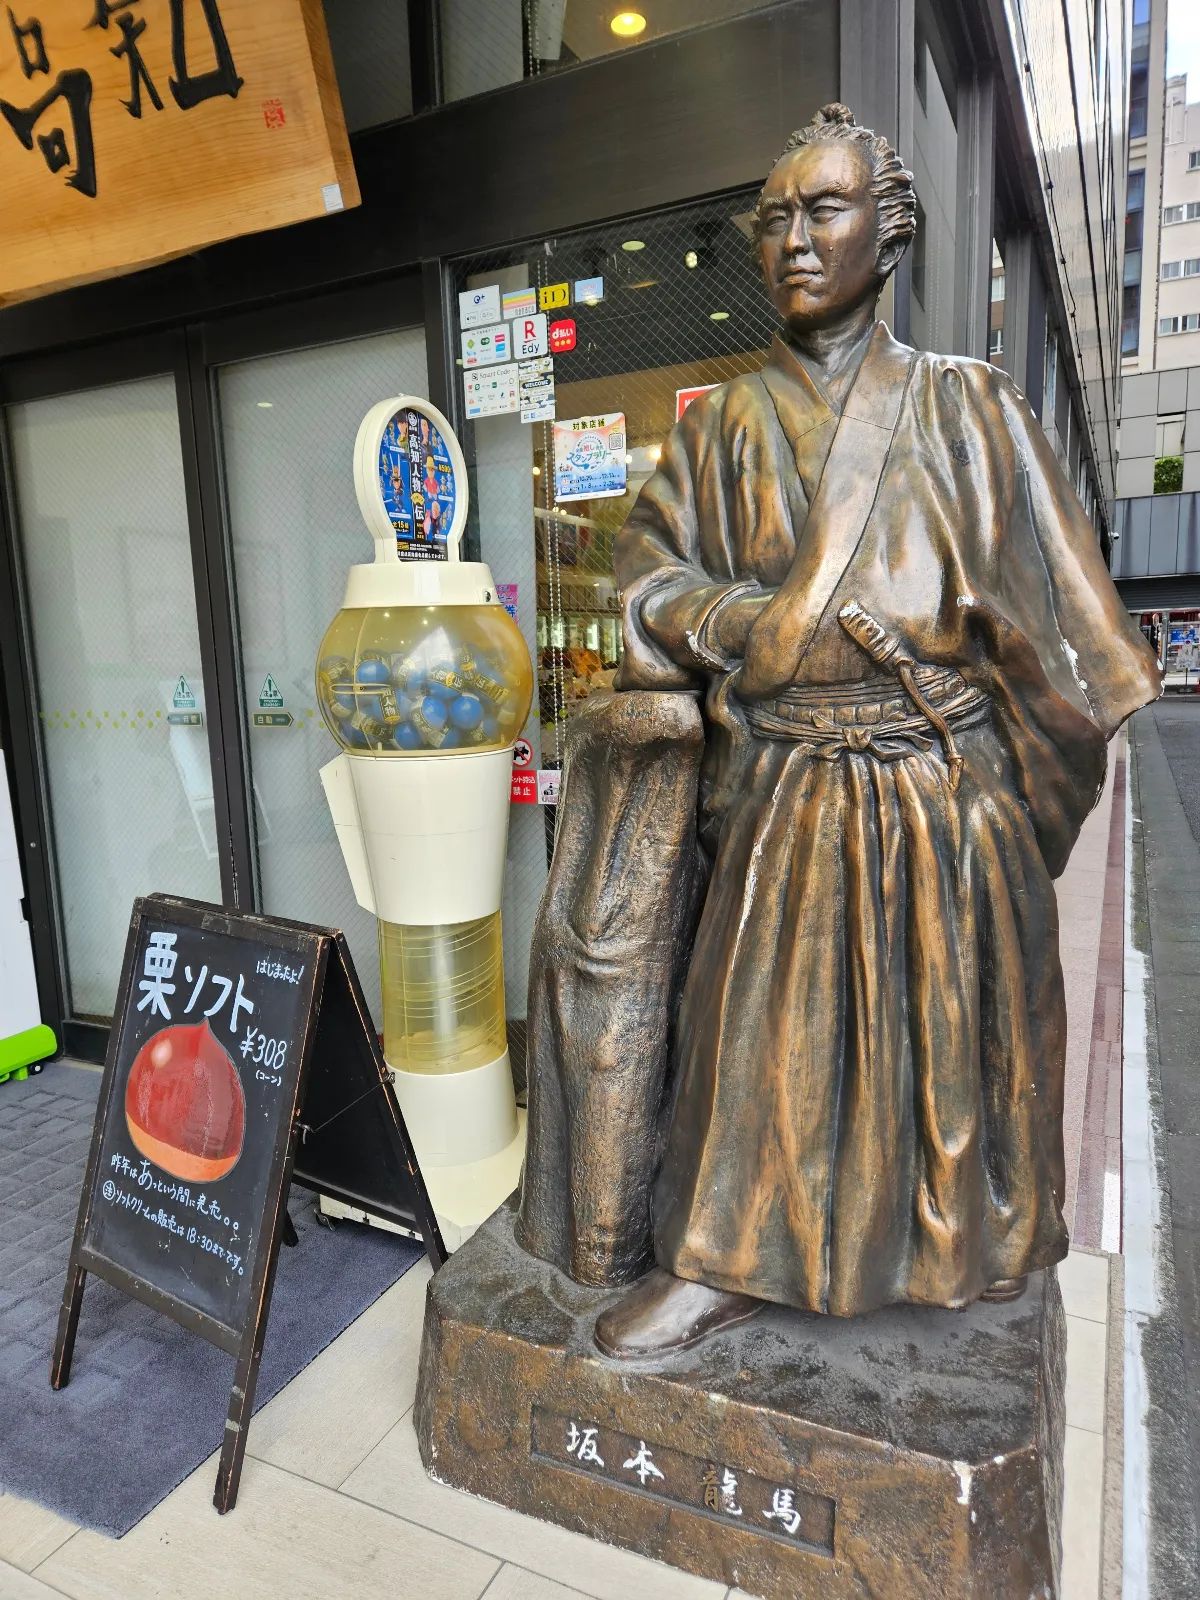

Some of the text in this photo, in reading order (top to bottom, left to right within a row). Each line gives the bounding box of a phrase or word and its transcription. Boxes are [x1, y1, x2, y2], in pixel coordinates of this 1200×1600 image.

[522, 343, 540, 354] Edy
[524, 380, 549, 388] WELCOME
[572, 418, 606, 431] 対象店舗
[512, 786, 532, 796] 禁止
[137, 930, 254, 1033] 栗ソフト
[240, 1025, 288, 1071] ¥308
[566, 1421, 801, 1534] 坂本龍馬
